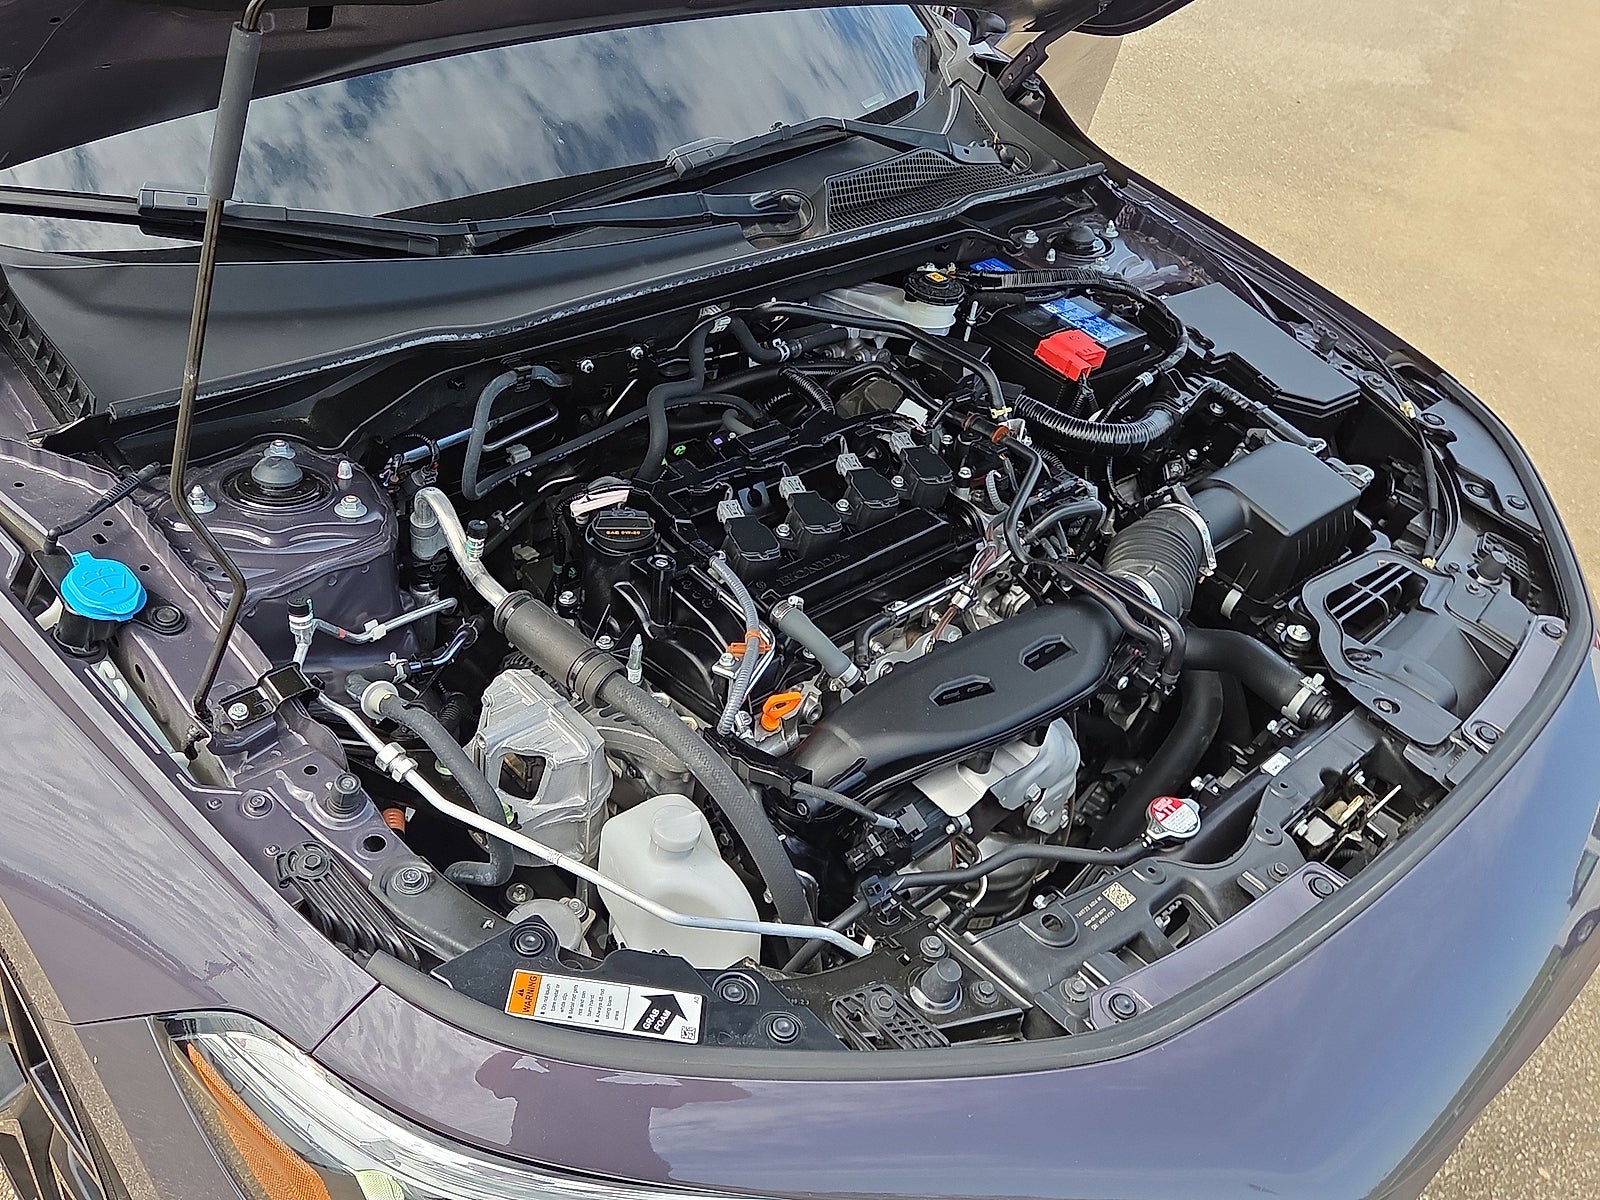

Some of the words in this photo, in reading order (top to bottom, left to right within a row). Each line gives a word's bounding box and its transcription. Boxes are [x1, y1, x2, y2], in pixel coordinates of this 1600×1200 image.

[776, 554, 850, 587] HONDA
[522, 975, 538, 1013] WARNING
[642, 1008, 660, 1030] GRAB
[653, 1009, 672, 1032] FOAM
